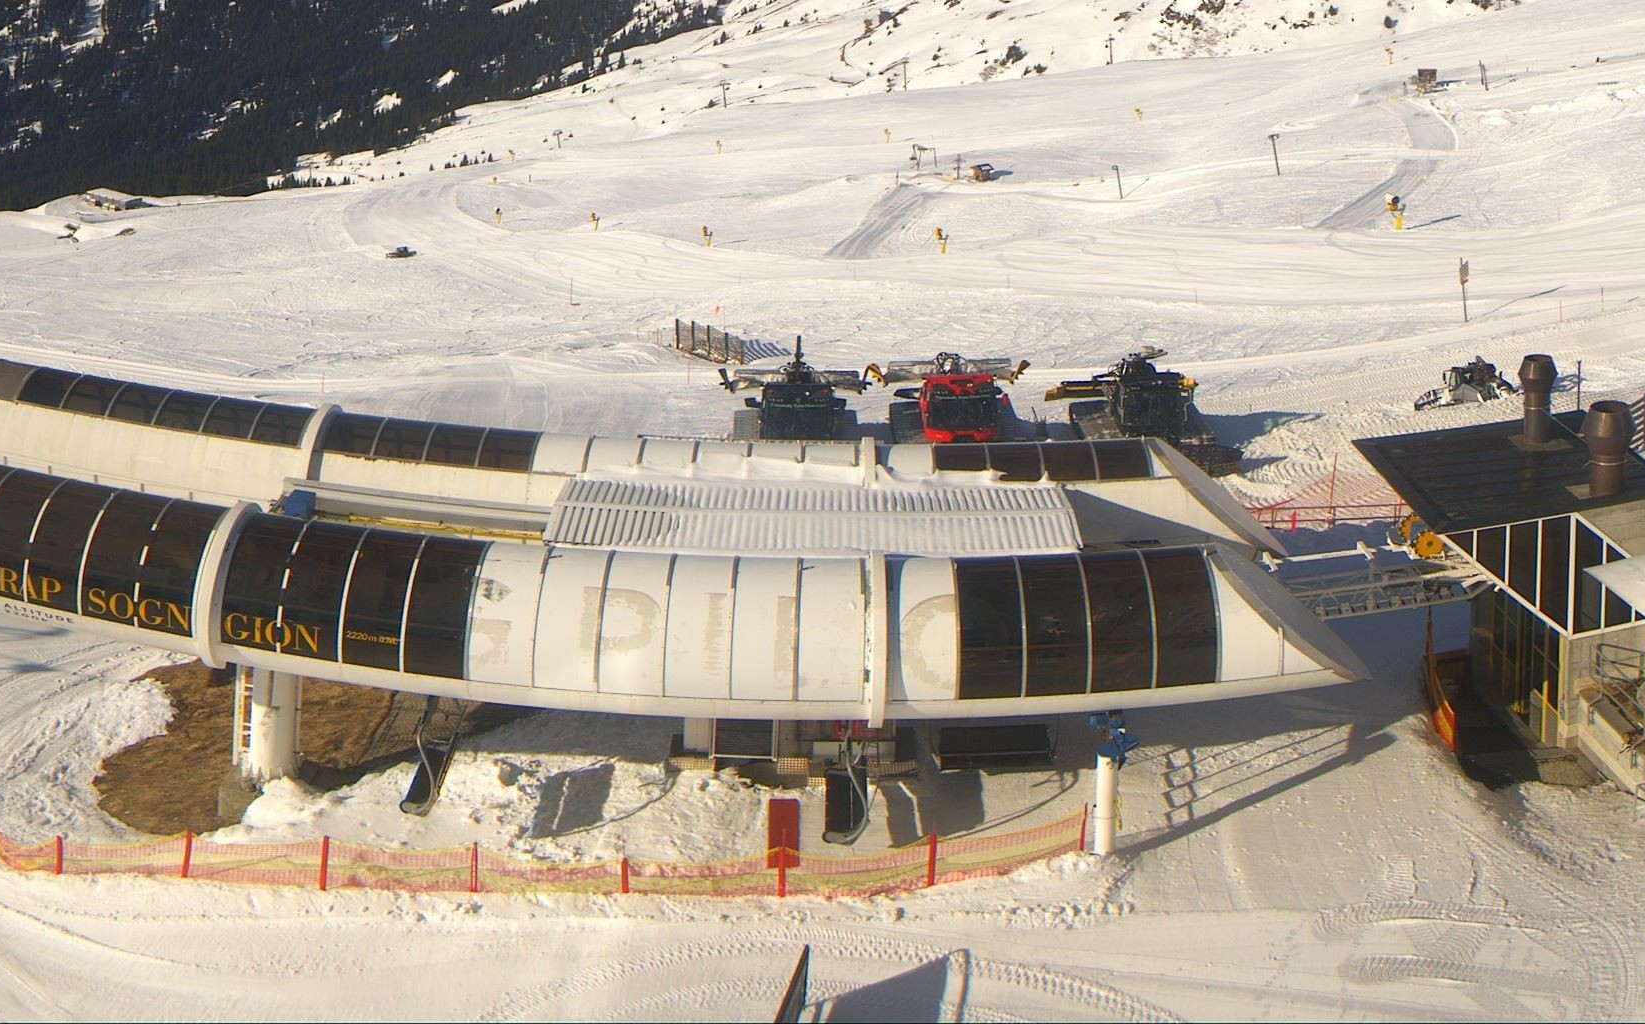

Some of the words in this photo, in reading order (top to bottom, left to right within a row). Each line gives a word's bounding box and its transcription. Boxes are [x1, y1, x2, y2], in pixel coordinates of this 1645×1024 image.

[4, 602, 75, 624] ALTITUDE
[87, 587, 191, 632] SOGN
[224, 612, 321, 653] GION
